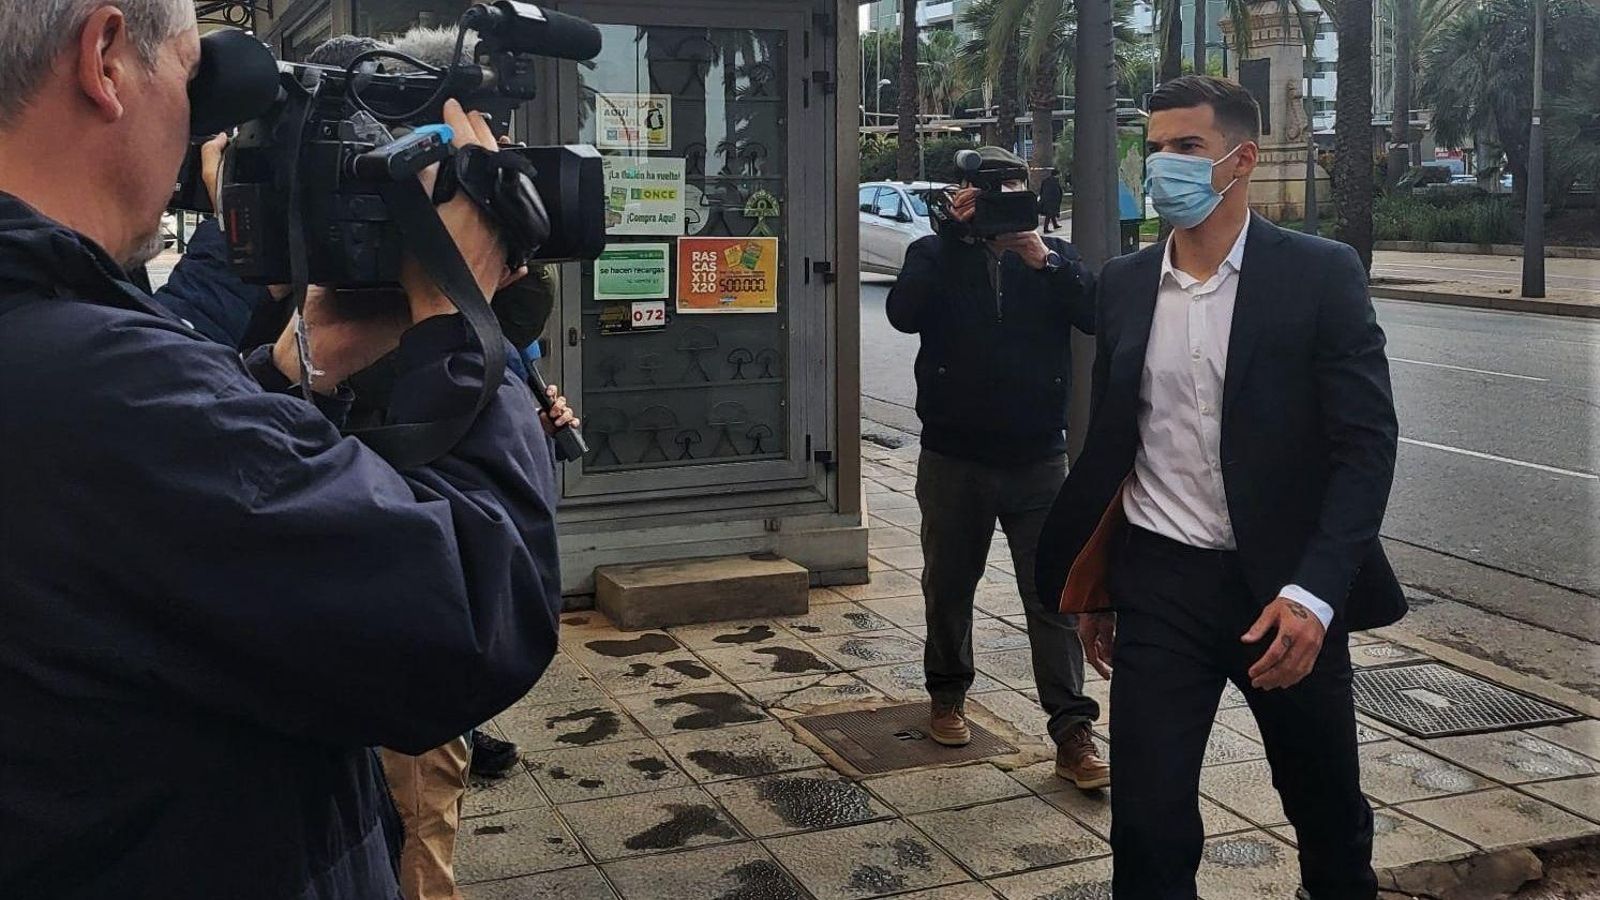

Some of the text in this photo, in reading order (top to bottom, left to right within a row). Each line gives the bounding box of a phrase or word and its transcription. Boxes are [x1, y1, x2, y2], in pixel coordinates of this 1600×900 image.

[646, 170, 656, 180] ha
[644, 190, 676, 199] ONCE
[627, 213, 656, 224] ¡Compra
[692, 252, 718, 262] RAS
[692, 262, 718, 272] CAS
[692, 272, 717, 282] X10
[692, 282, 717, 293] X20
